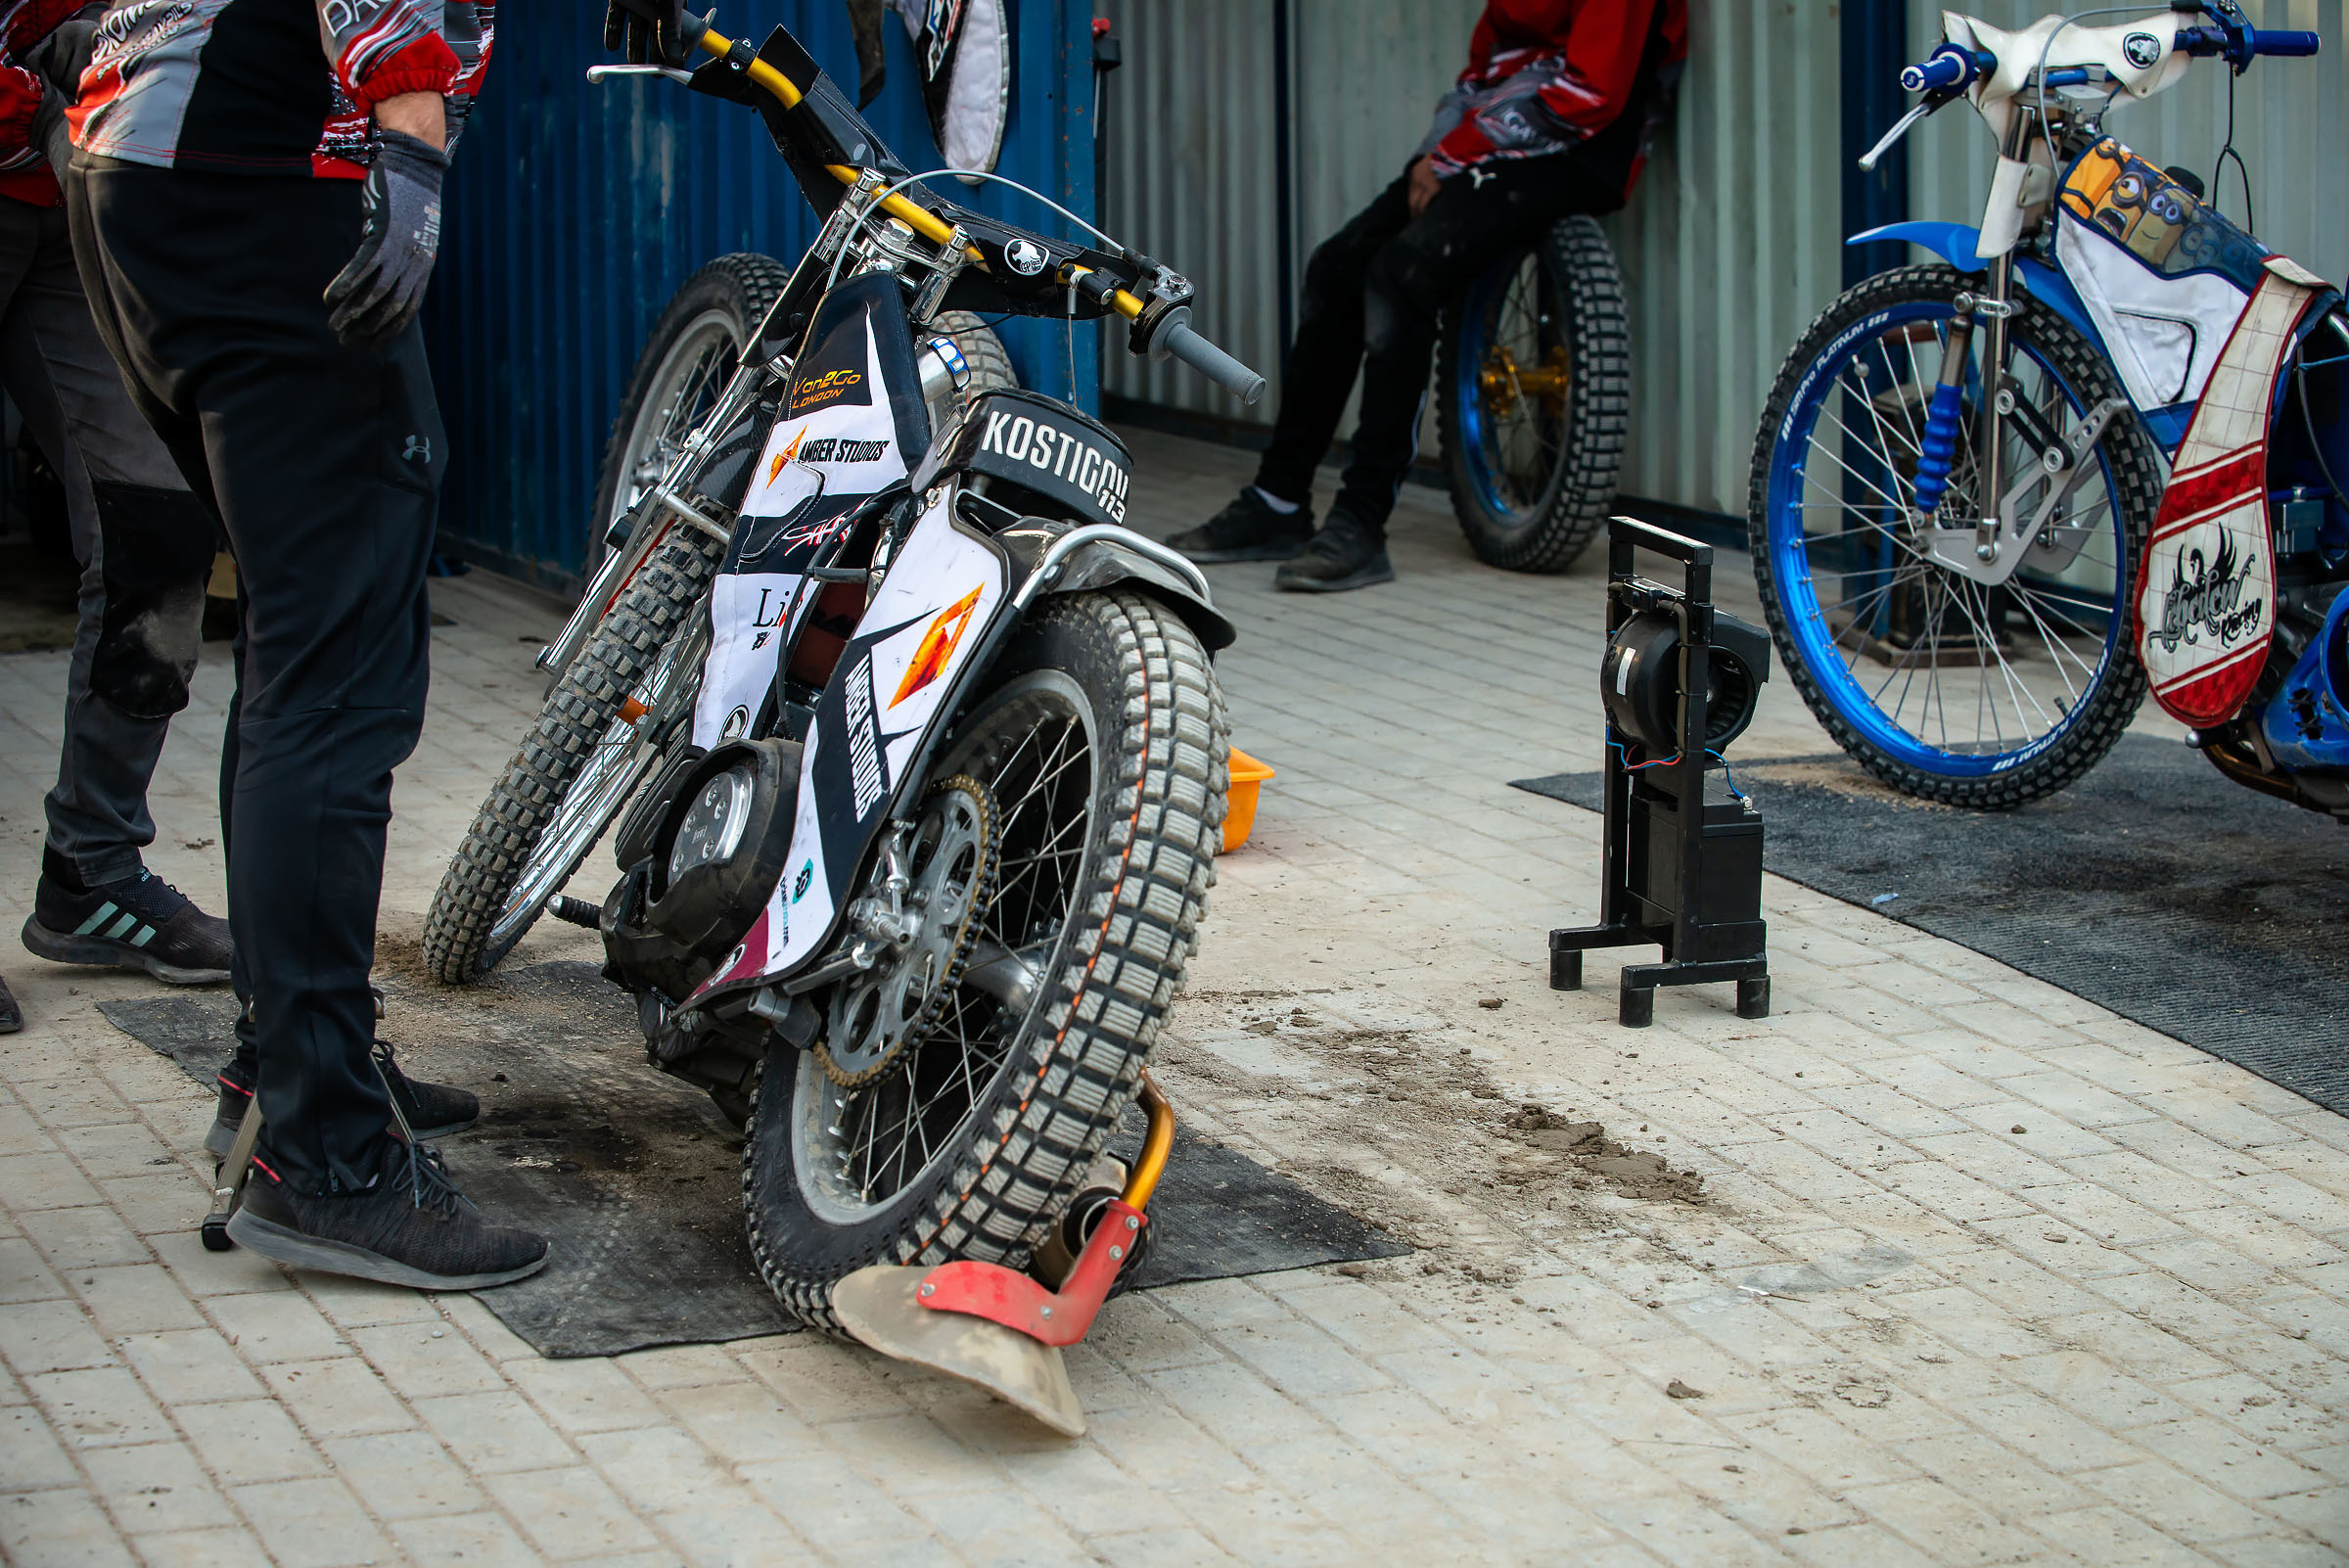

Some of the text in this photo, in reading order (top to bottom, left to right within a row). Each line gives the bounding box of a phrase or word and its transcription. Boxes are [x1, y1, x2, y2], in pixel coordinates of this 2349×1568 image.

[1816, 322, 1865, 371] PLATINUM
[791, 389, 845, 409] LONDON
[799, 438, 891, 464] AMBER STUDIOS
[1097, 488, 1127, 525] 113
[845, 654, 884, 823] AMBER STUDIOS
